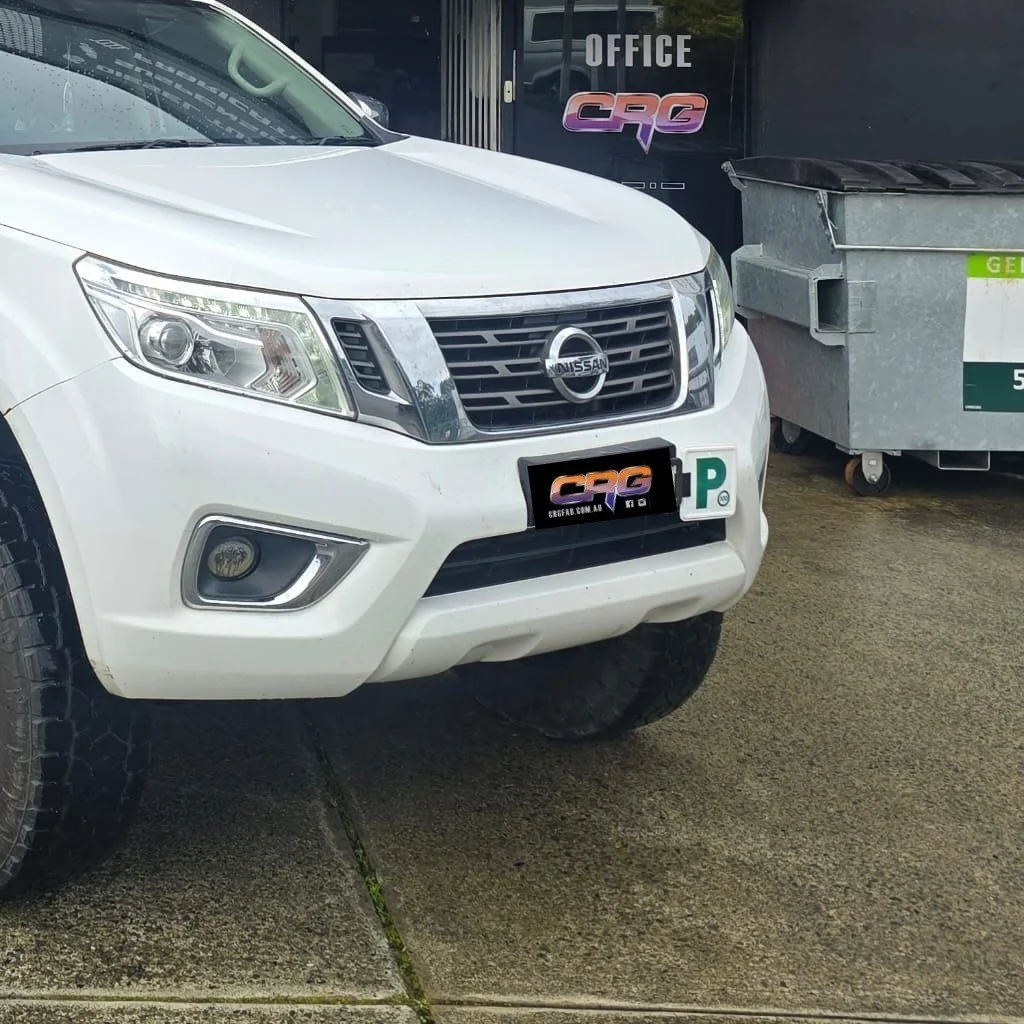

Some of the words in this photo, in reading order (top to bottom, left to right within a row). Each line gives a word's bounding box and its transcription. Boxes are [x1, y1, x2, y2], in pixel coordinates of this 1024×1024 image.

[585, 33, 692, 68] OFFICE
[562, 91, 709, 154] CRG
[557, 358, 606, 373] NISSAN
[696, 457, 727, 509] P
